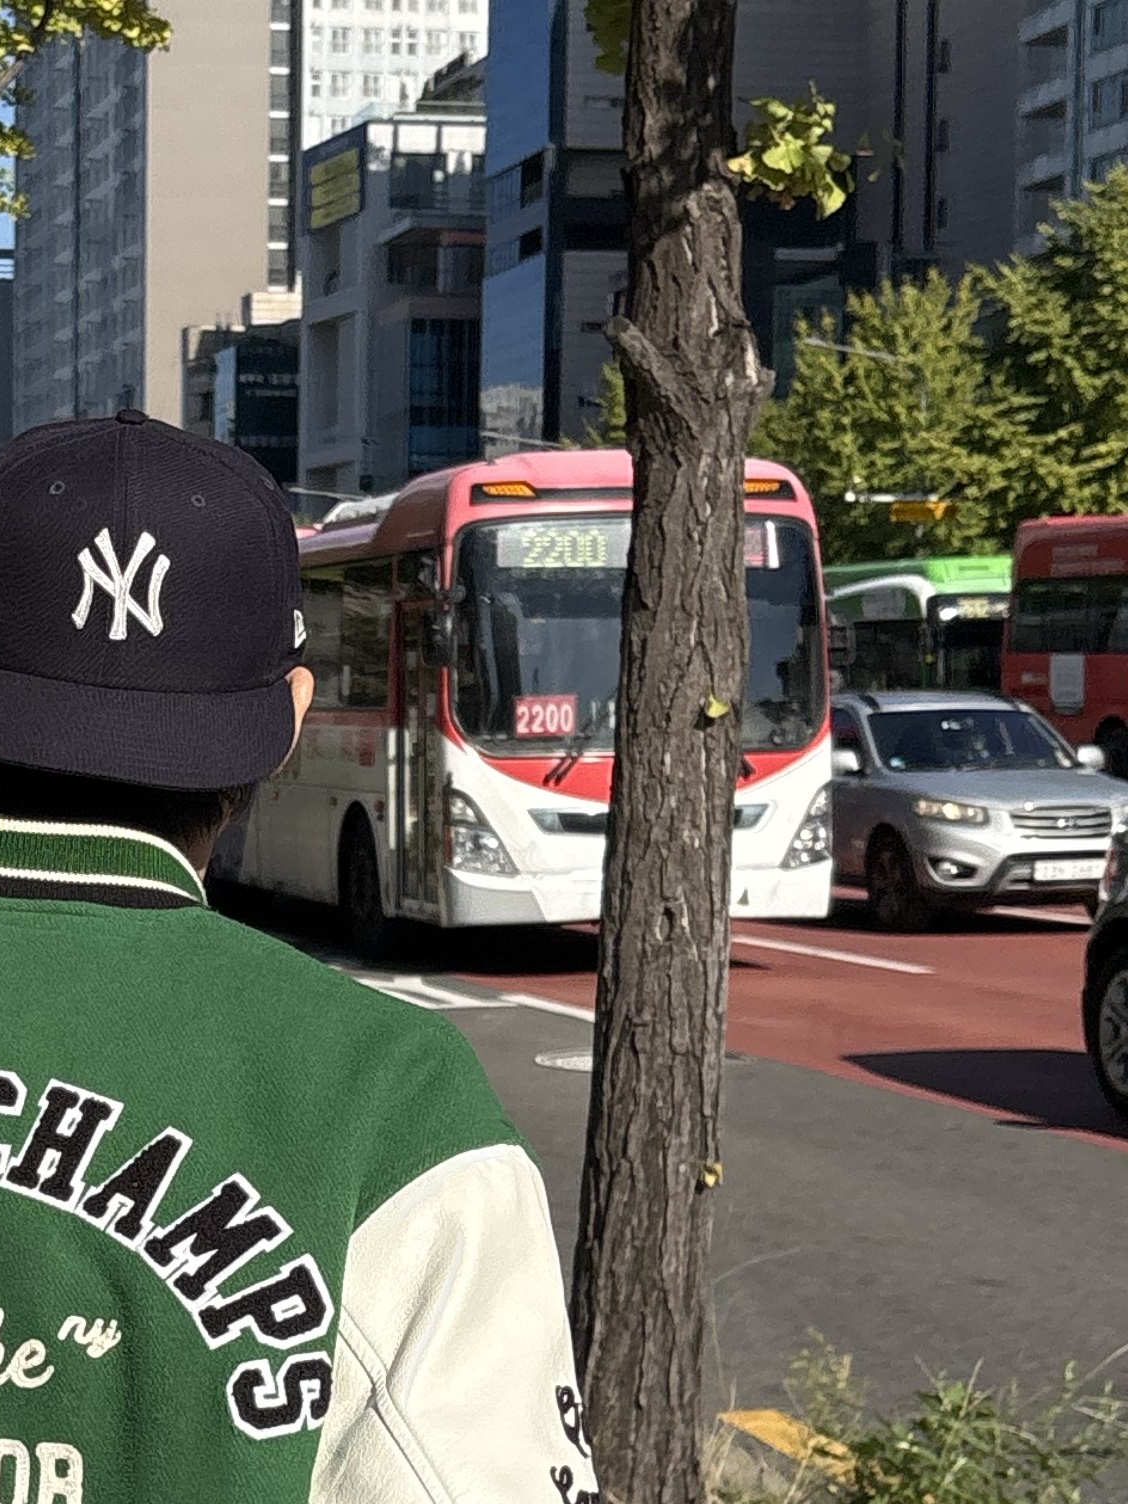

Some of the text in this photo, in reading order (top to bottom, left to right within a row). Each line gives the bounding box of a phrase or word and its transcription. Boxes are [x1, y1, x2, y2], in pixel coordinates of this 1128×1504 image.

[521, 528, 608, 568] 2200
[71, 526, 171, 641] NY
[516, 703, 574, 734] 2200
